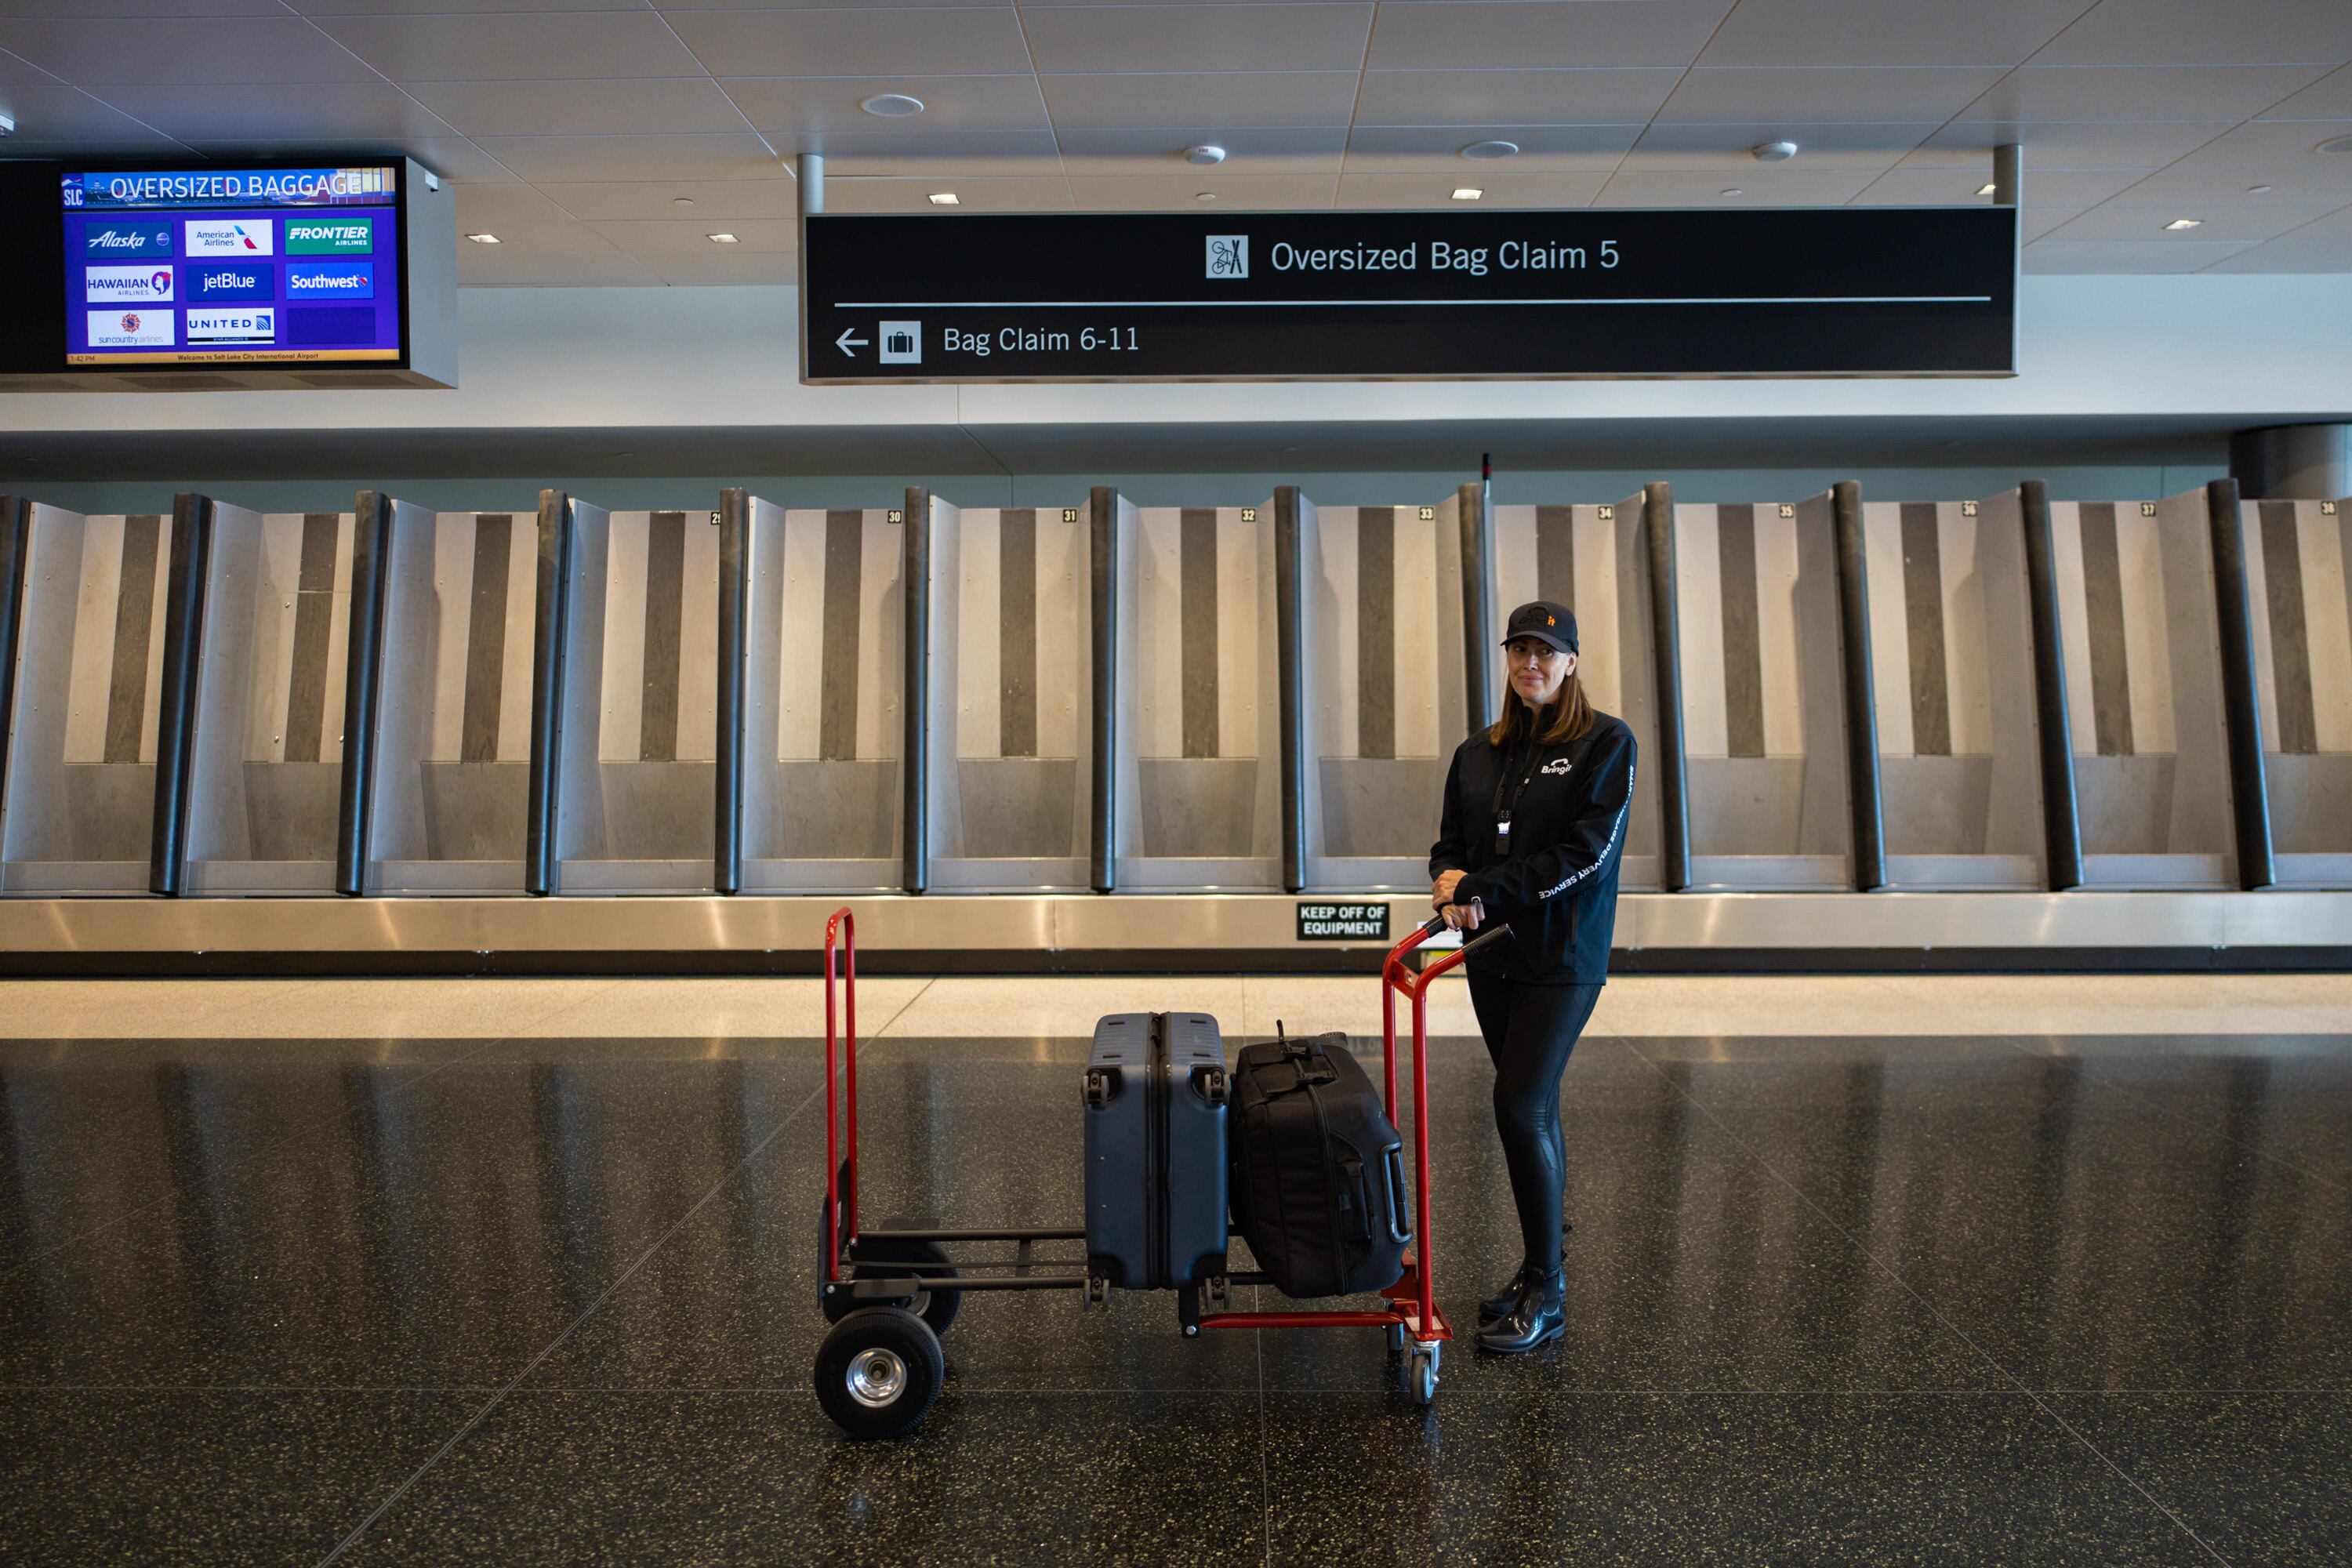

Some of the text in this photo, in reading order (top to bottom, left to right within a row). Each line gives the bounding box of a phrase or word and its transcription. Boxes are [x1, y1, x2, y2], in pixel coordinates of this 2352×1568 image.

[111, 175, 362, 198] OVERSIZED BAGGAGE
[64, 189, 83, 205] SLC
[89, 230, 145, 249] Alaska
[289, 227, 368, 239] FRONTIER
[1272, 240, 1619, 275] Oversized Bag Claim 5
[88, 278, 149, 289] HAWAIIAN
[203, 273, 255, 292] jetBlue
[291, 274, 358, 289] Southwest
[189, 319, 252, 328] UNITED
[944, 327, 1138, 356] Bag Claim 6-11
[889, 511, 901, 523] 30
[1065, 510, 1076, 521] 31
[1243, 510, 1255, 521] 32
[1420, 508, 1433, 519] 33
[1599, 507, 1612, 518] 34
[1541, 764, 1572, 775] Bringit
[1578, 844, 1613, 879] DELIVERY
[1538, 876, 1578, 899] SERVICE
[1301, 906, 1386, 919] KEEP OFF OF
[1304, 922, 1382, 935] EQUIPMENT
